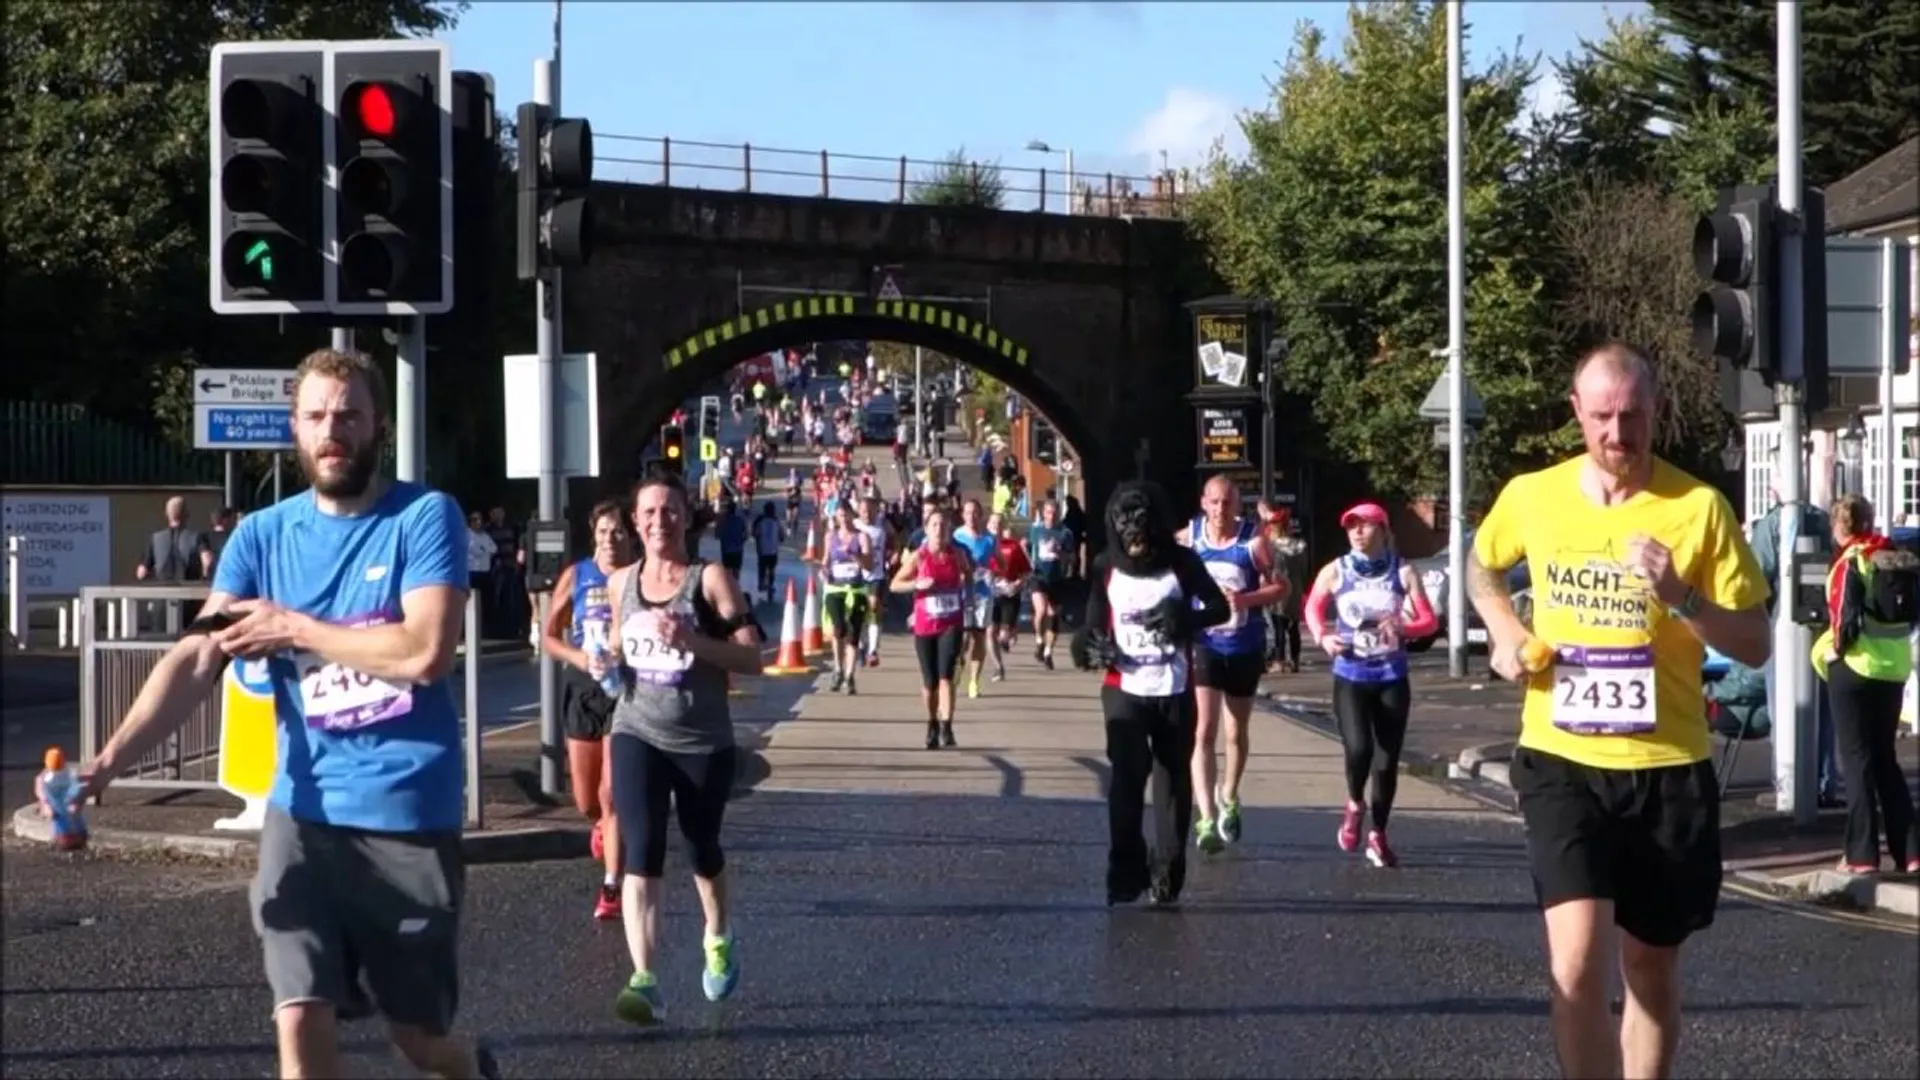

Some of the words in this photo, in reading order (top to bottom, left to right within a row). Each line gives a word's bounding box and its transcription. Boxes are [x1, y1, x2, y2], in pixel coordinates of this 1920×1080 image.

[229, 373, 277, 386] Polsloe
[231, 388, 275, 400] Bridge
[212, 411, 234, 424] No
[236, 411, 267, 427] right
[269, 412, 289, 425] tur
[226, 425, 244, 438] 60
[246, 425, 283, 440] yards
[1546, 563, 1622, 593] NACHT
[1551, 590, 1648, 614] MARATHON
[1560, 676, 1647, 710] 2433
